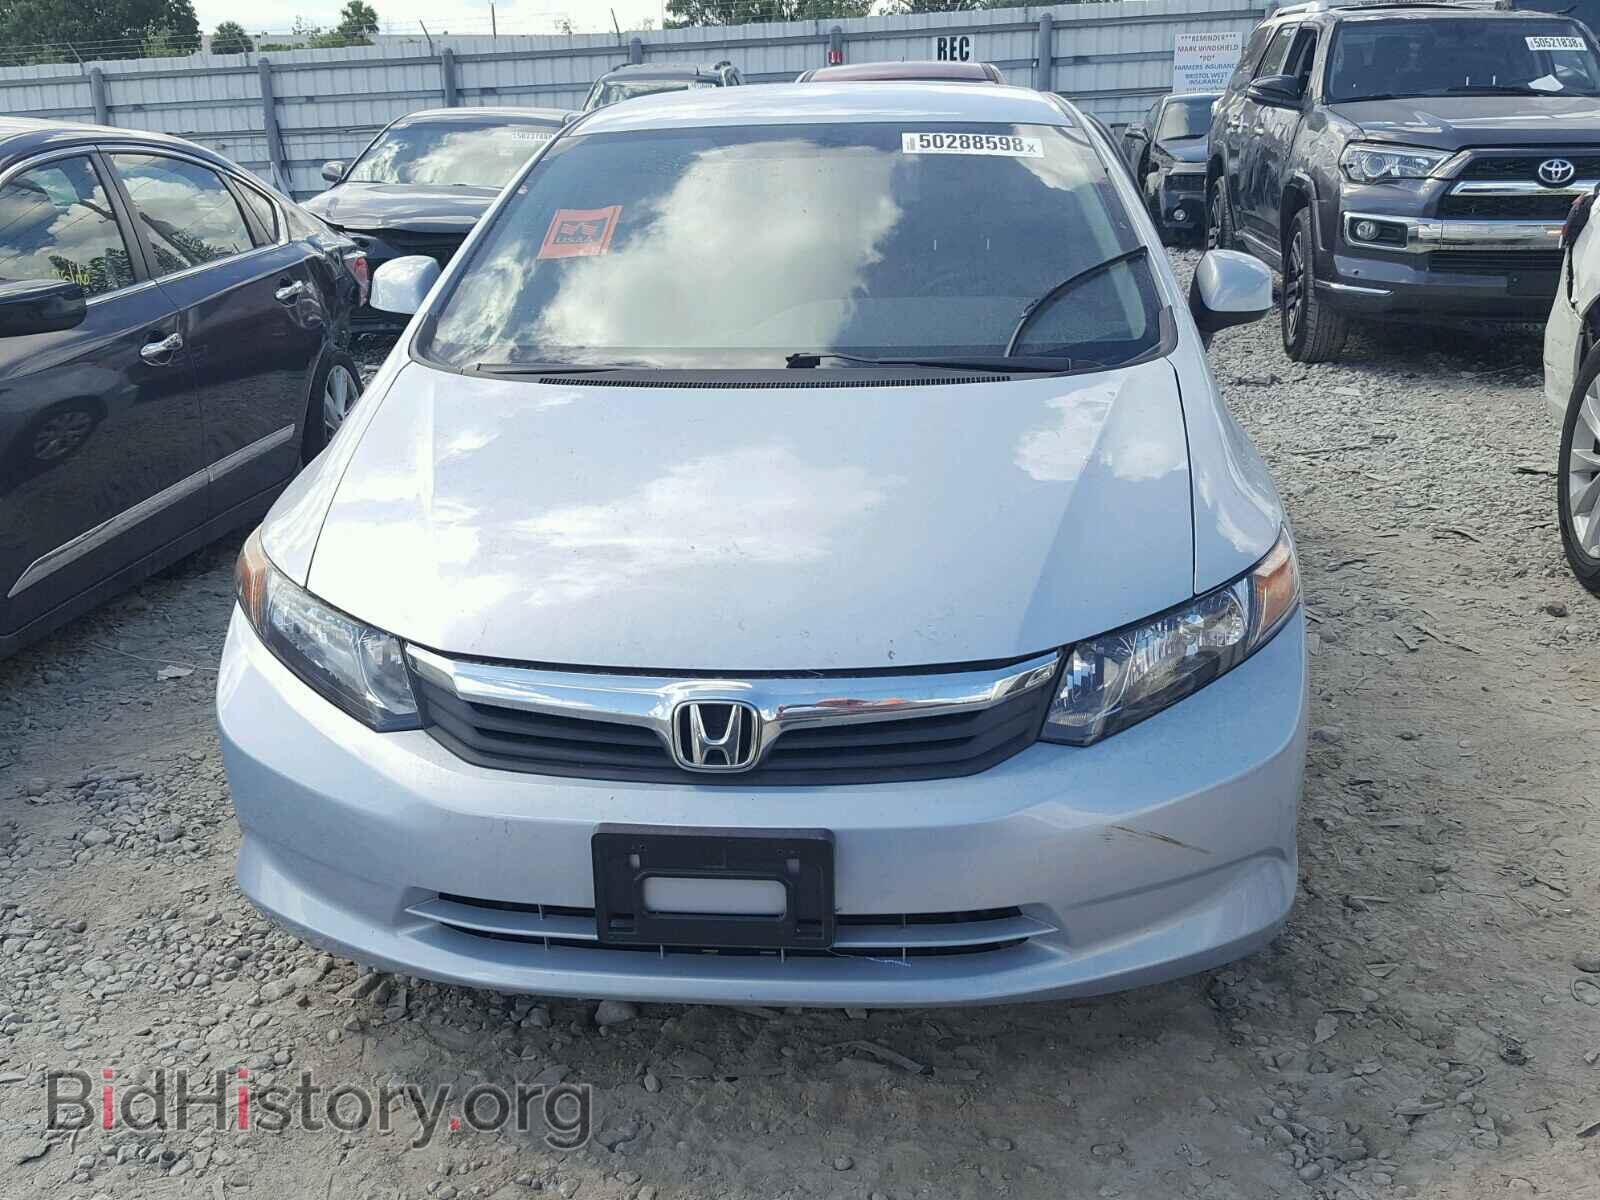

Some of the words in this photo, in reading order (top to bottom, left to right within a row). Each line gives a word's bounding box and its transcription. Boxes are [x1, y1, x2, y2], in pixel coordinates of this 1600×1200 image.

[937, 36, 970, 62] REC
[1199, 44, 1239, 52] WINDSHIELD
[919, 133, 1025, 152] 50288598
